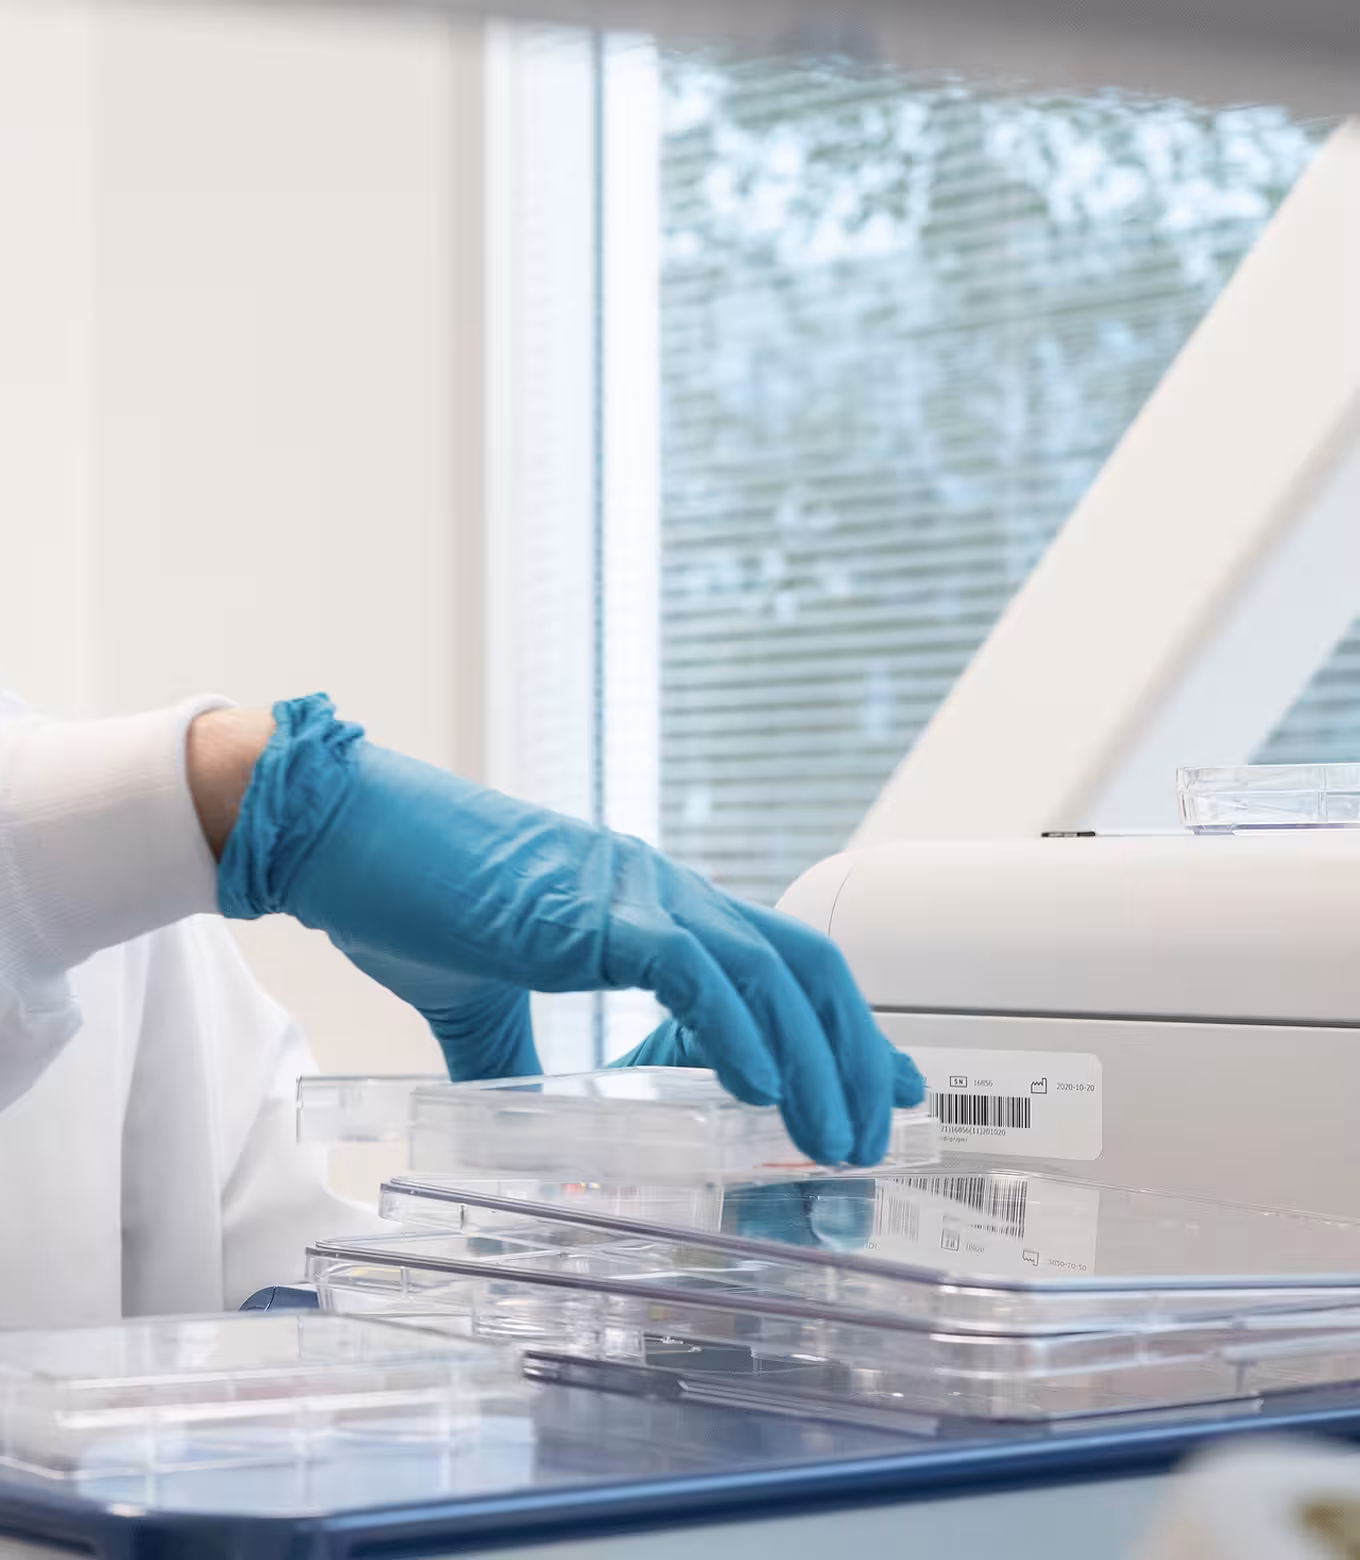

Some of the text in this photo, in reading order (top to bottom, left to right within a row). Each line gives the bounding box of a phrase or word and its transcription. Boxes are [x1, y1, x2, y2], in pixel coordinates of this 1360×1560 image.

[973, 1079, 994, 1088] 16856
[1056, 1082, 1096, 1092] 2020-10-20
[940, 1125, 1006, 1136] 21)16856(11)201020
